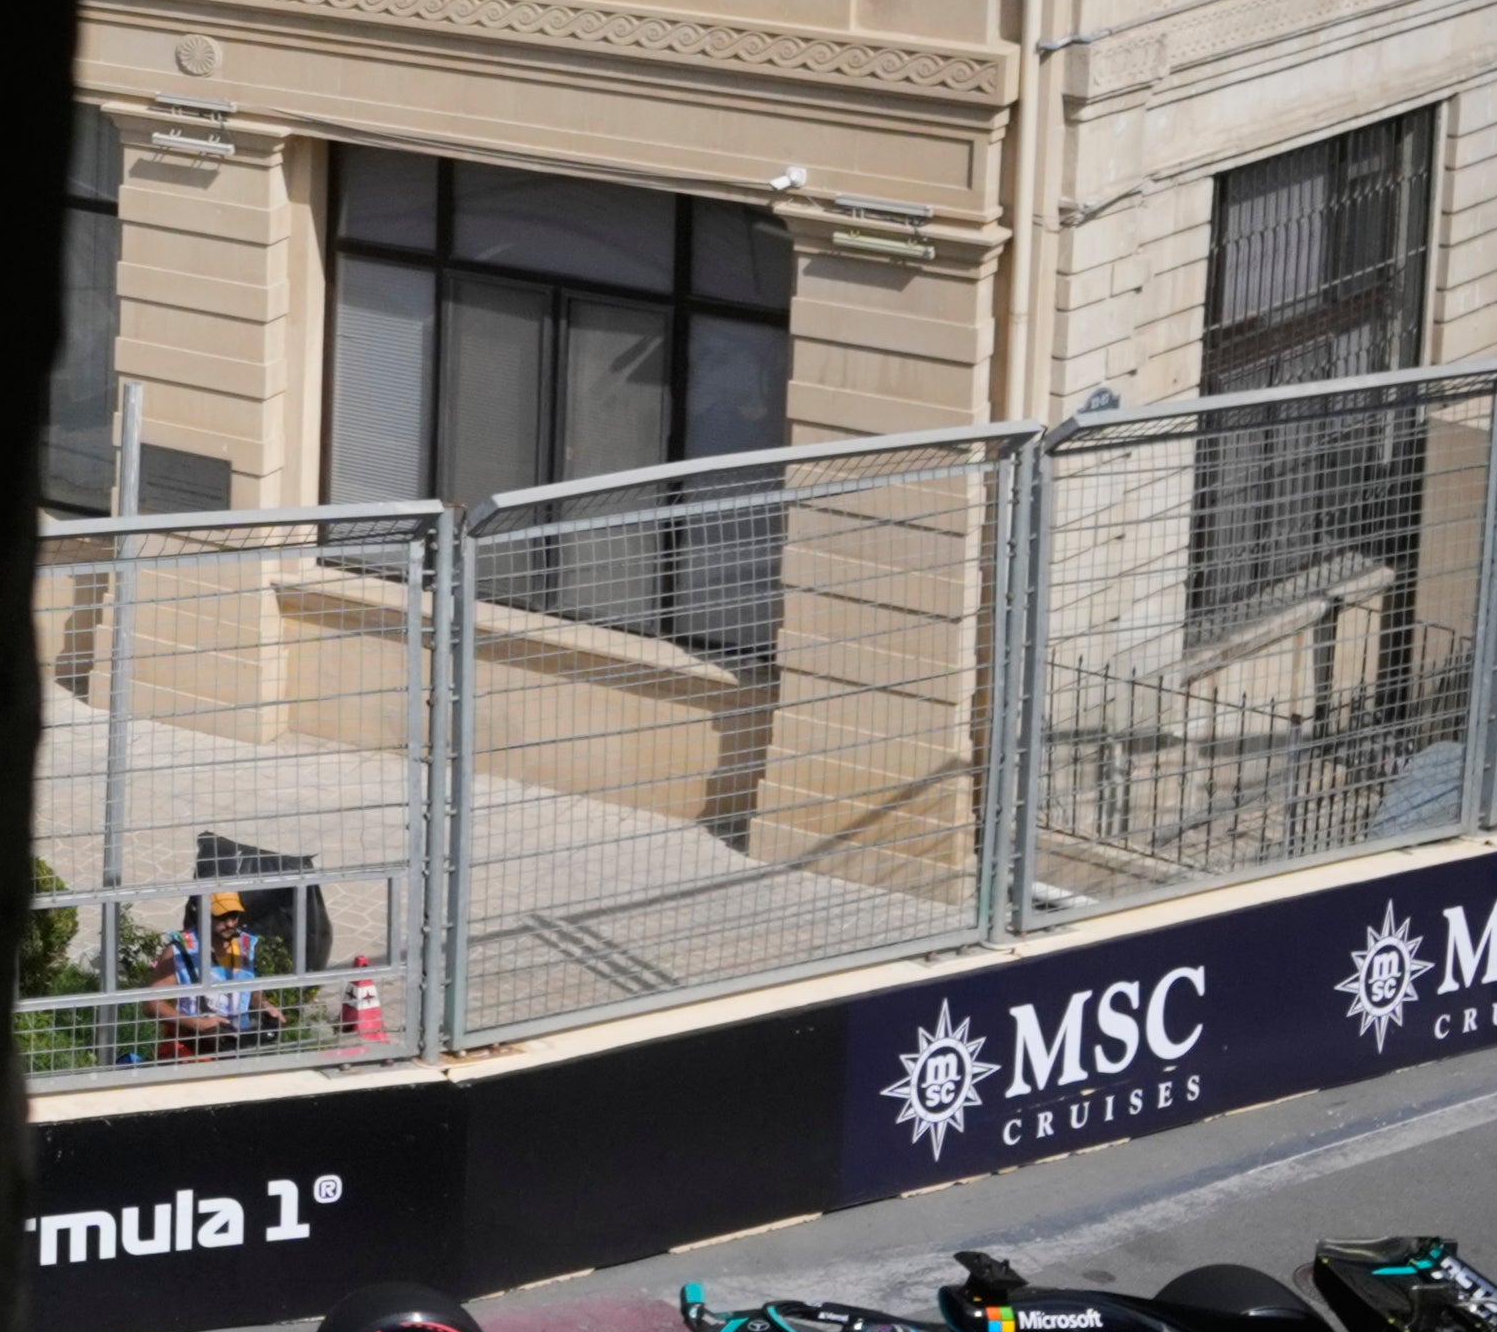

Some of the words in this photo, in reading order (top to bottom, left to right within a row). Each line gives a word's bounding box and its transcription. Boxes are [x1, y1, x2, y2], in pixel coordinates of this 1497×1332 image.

[1005, 966, 1206, 1099] MSC
[1003, 1074, 1201, 1147] CRUISES
[25, 1188, 245, 1267] mula
[1017, 1307, 1104, 1330] Microsoft
